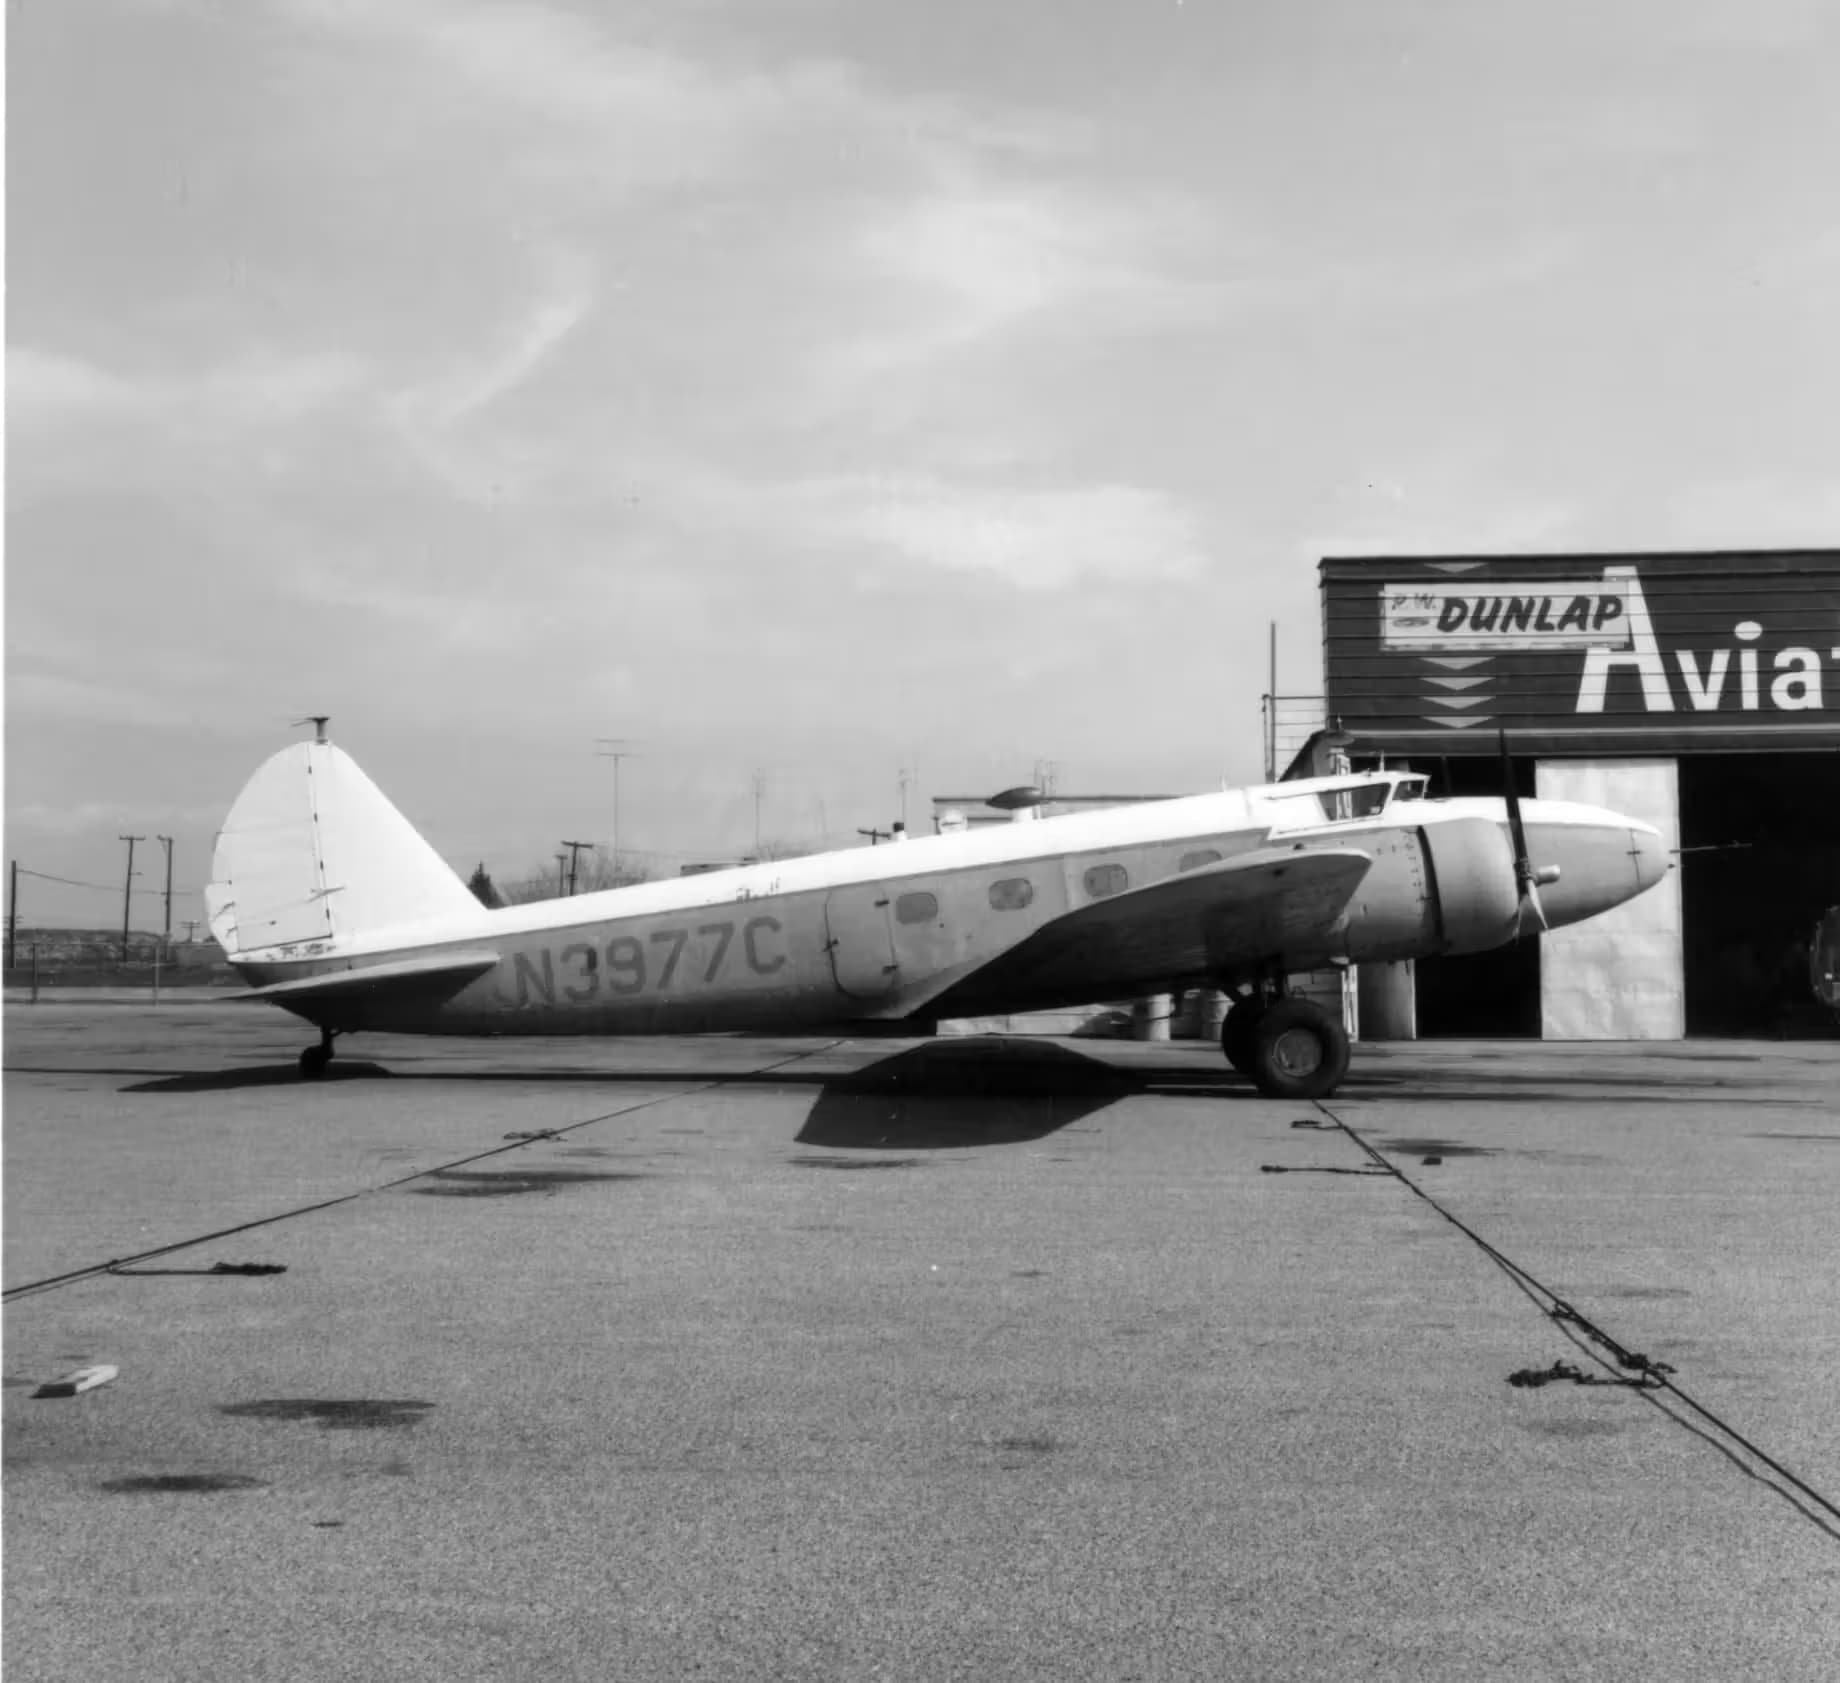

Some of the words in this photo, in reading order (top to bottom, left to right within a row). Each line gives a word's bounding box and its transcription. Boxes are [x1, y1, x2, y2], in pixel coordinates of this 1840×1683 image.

[1437, 595, 1623, 633] DUNLAP
[1575, 565, 1840, 713] Avia
[513, 915, 785, 1009] N3977C
